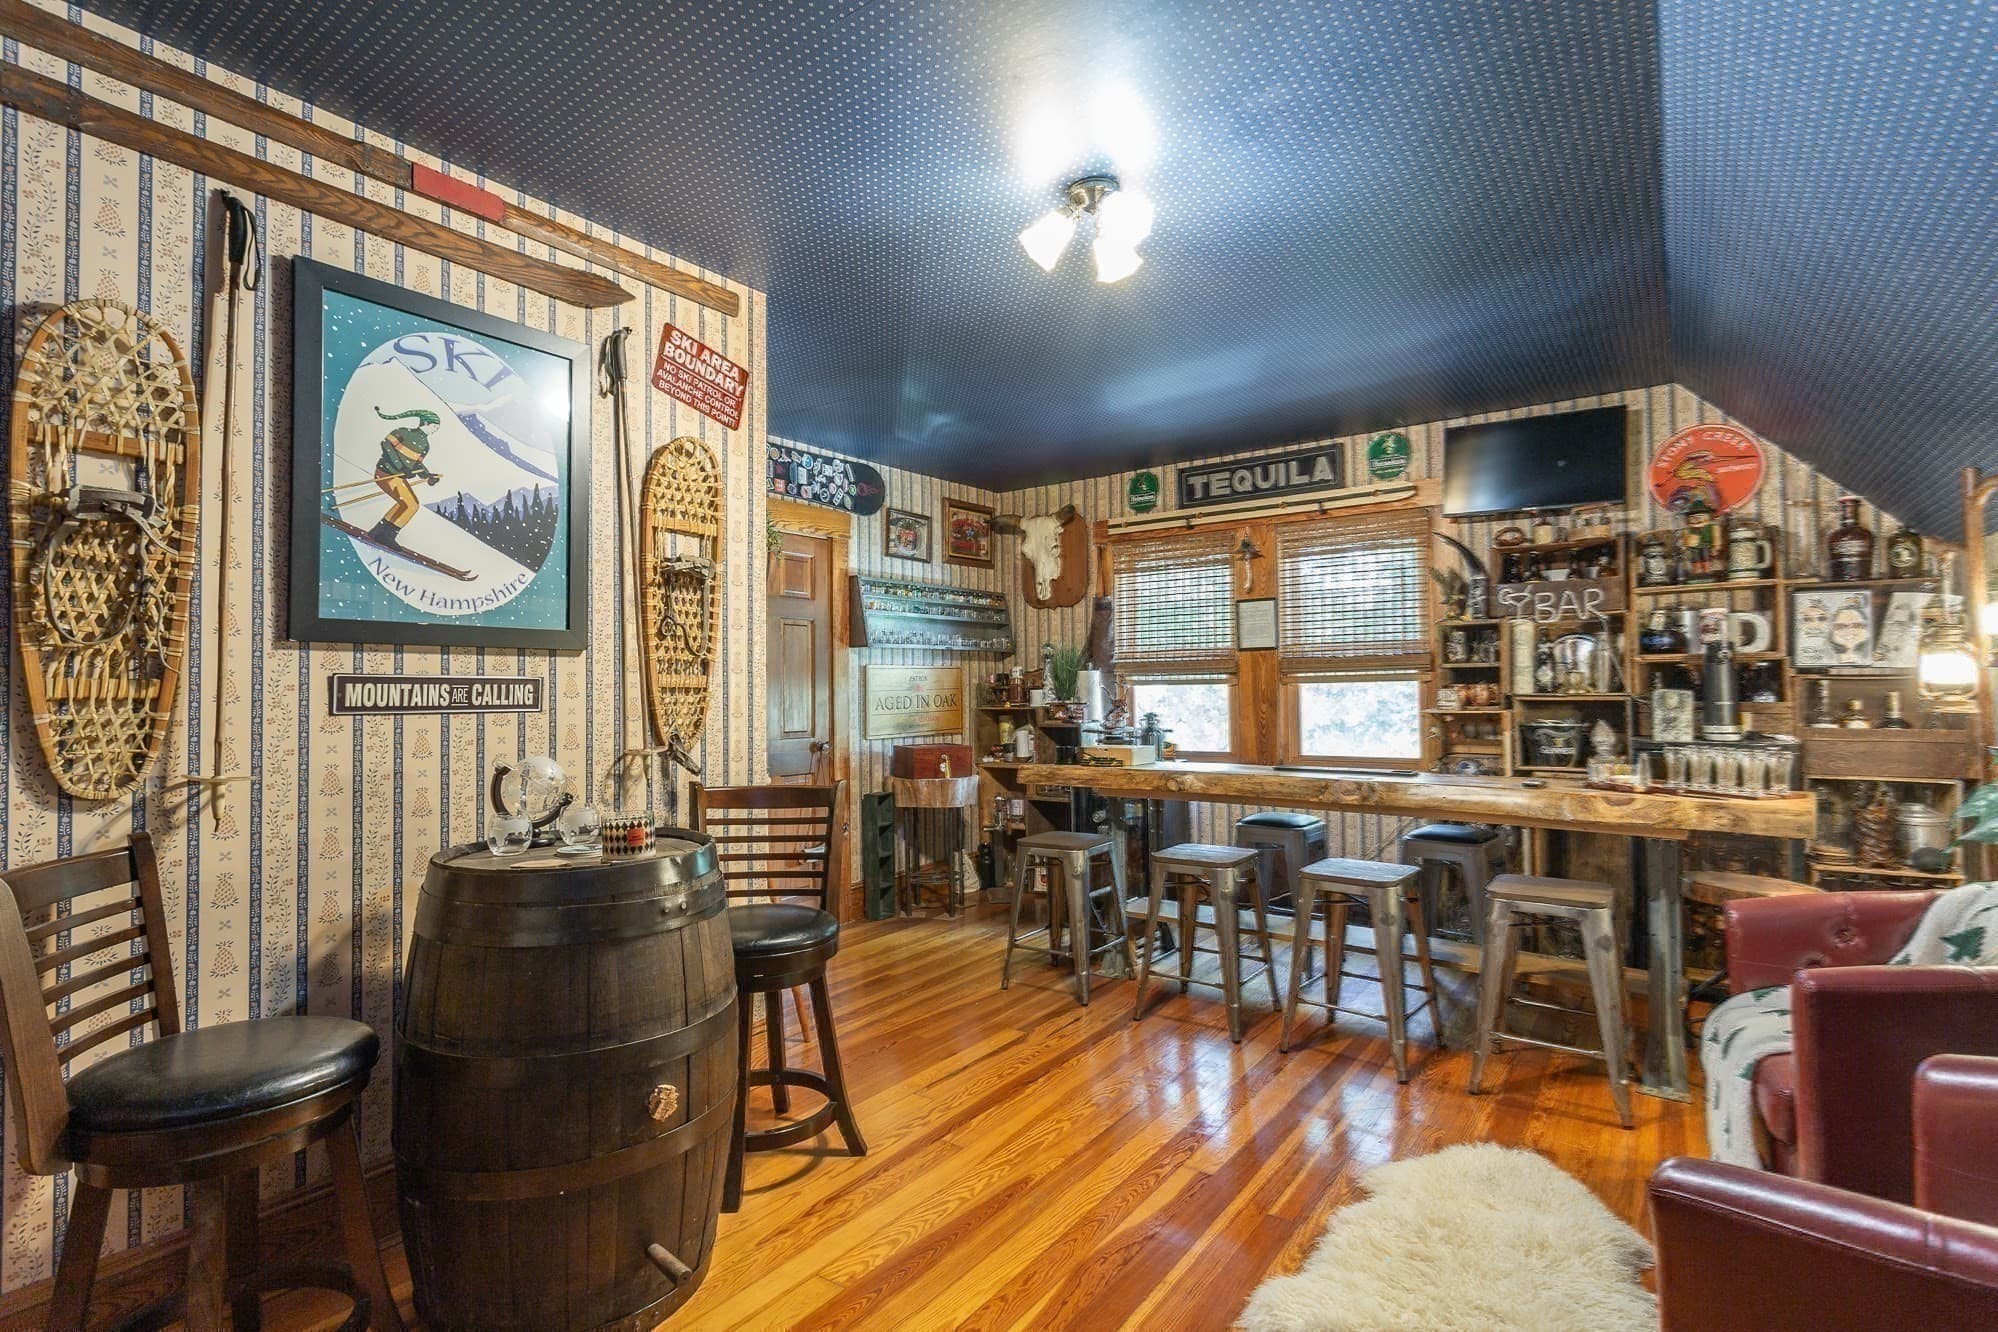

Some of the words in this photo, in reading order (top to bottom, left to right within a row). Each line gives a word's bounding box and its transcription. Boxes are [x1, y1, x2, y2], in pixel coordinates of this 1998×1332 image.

[393, 334, 514, 392] SKI
[663, 341, 744, 397] BOUNDARY
[670, 329, 698, 356] SKI
[700, 349, 739, 382] AREA
[657, 368, 704, 400] AVALANCHE
[704, 394, 740, 420] CONTROL
[658, 379, 692, 403] BEYOND
[693, 398, 710, 413] THIS
[664, 361, 677, 374] NO
[678, 369, 693, 383] SKI
[694, 378, 725, 401] PATROL
[724, 396, 736, 408] OR
[1702, 430, 1752, 451] CREEK
[1186, 456, 1335, 499] TEQUILA
[367, 555, 416, 597] New
[419, 572, 529, 612] Hampshire
[1534, 588, 1608, 623] BAR
[344, 682, 450, 708] MOUNTAINS
[452, 687, 469, 703] ARE
[471, 683, 534, 706] CALLING
[875, 695, 912, 711] AGED
[915, 694, 930, 708] IN
[933, 693, 957, 708] OAK
